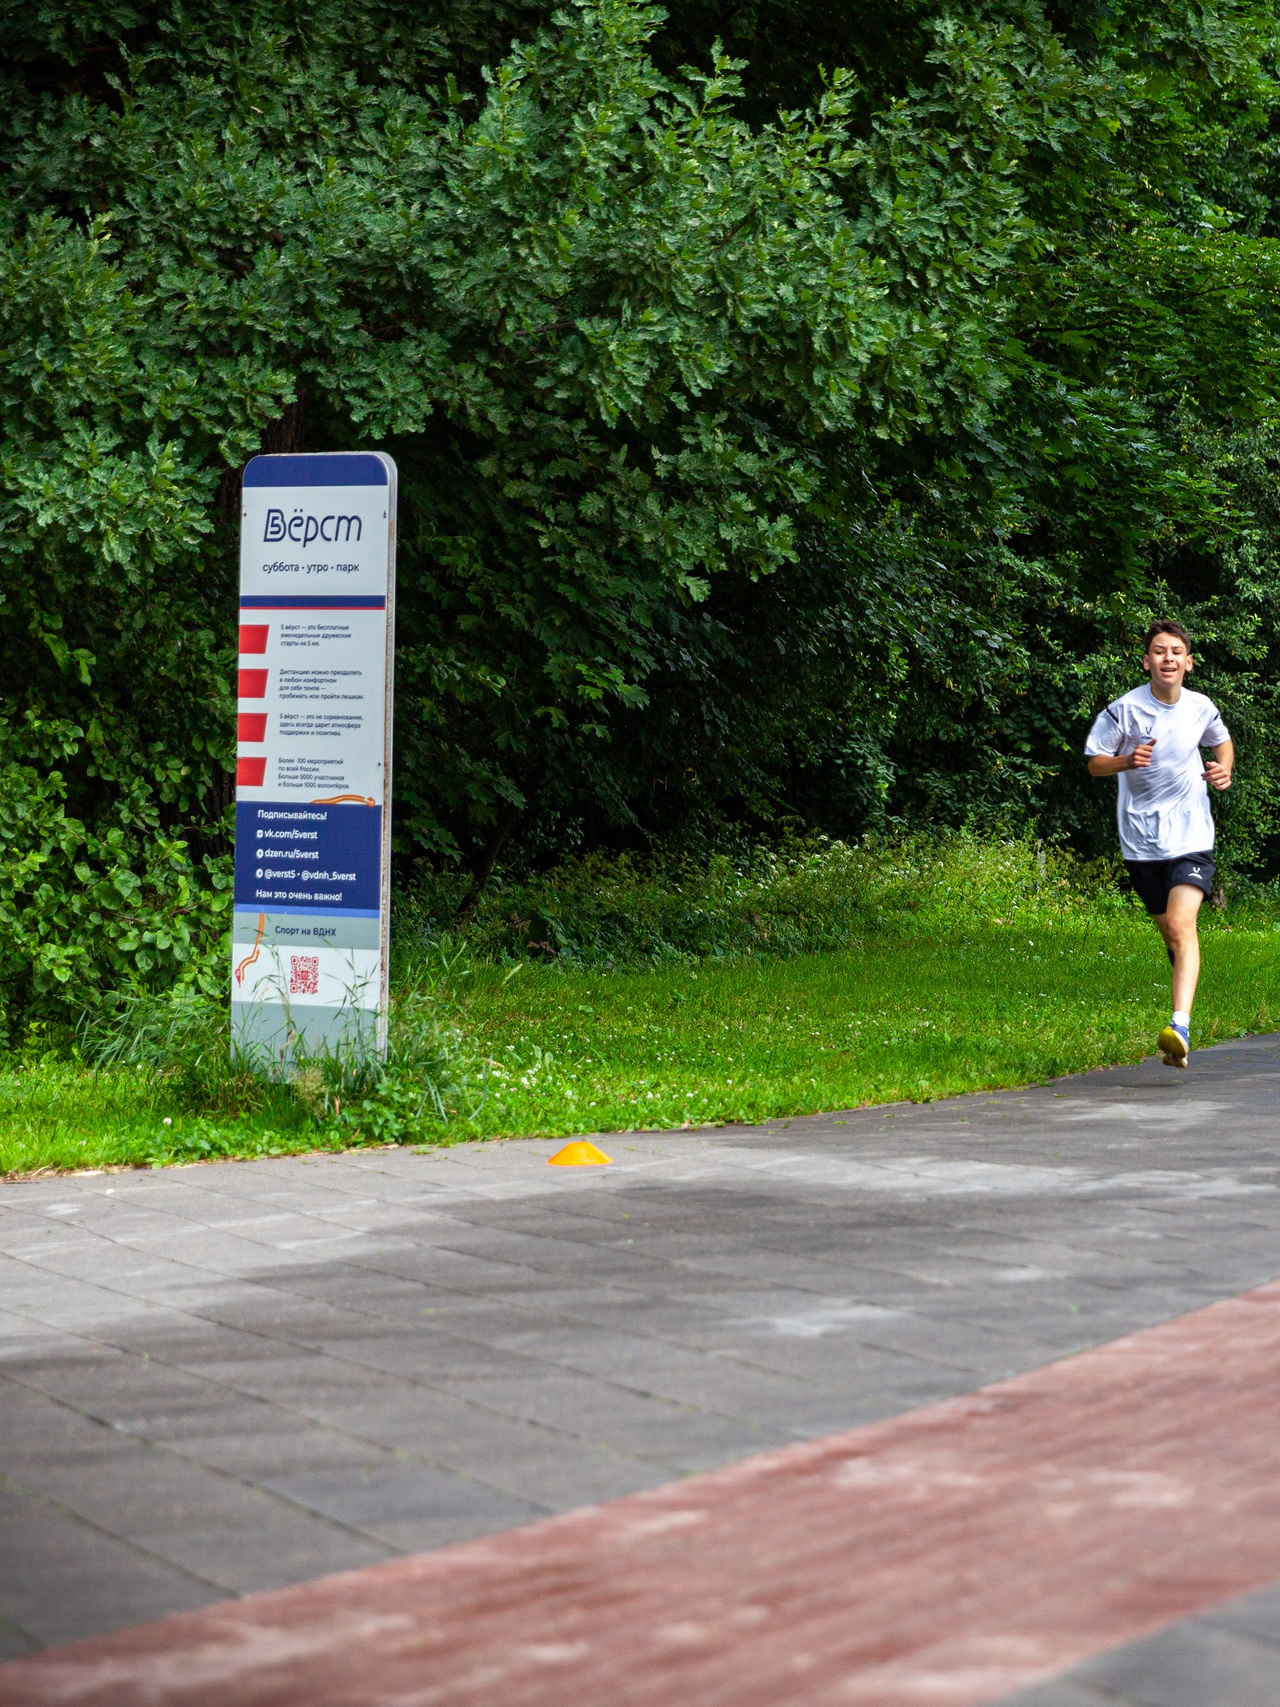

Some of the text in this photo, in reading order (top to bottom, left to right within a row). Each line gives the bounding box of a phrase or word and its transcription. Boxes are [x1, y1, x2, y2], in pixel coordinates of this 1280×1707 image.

[262, 561, 360, 574] суббота утро парк
[257, 809, 328, 820] Подписывайтесь!
[264, 829, 318, 839] vk.com/5verst
[264, 848, 319, 859] dzen.ru/5verst
[264, 868, 357, 881] @verst5 @vdnh_5verst
[255, 889, 343, 901] Нам это очень важно!
[275, 925, 300, 936] Спорт
[313, 927, 337, 937] ВДНХ
